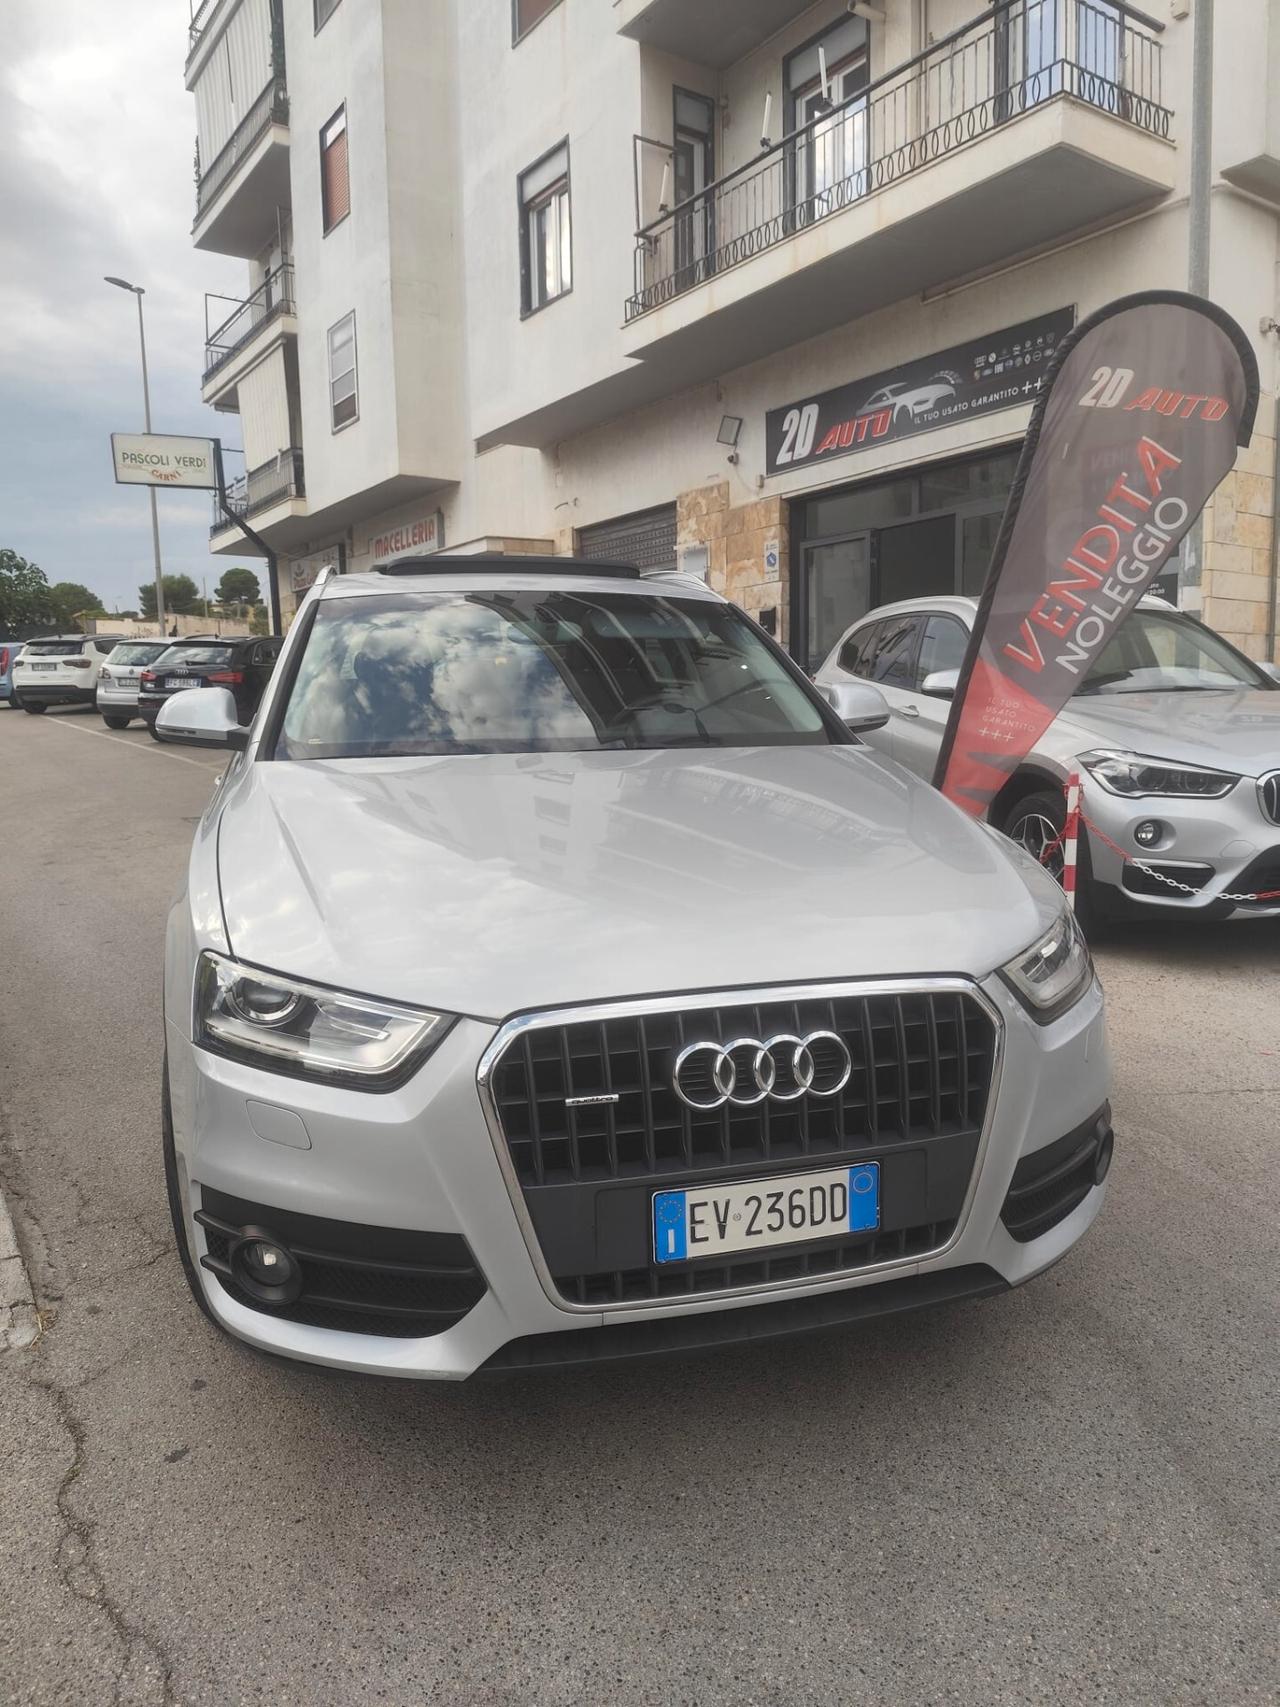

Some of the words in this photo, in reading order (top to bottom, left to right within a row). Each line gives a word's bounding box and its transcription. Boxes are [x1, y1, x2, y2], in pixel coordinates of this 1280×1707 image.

[923, 412, 940, 421] TUO
[942, 402, 969, 416] USATO
[971, 387, 1019, 407] GARANTITO
[1078, 366, 1134, 408] 2D
[1123, 387, 1229, 421] AUTO
[776, 403, 819, 465] 2D
[816, 407, 892, 454] AUTO
[121, 452, 170, 466] PASCOLI
[151, 468, 182, 481] CARNI
[375, 518, 435, 559] MACELLERIA
[1003, 436, 1182, 673] VENDITA
[1055, 497, 1188, 674] NOLEGGIO
[982, 715, 1036, 732] GARANTITO
[985, 706, 1017, 718] USATO
